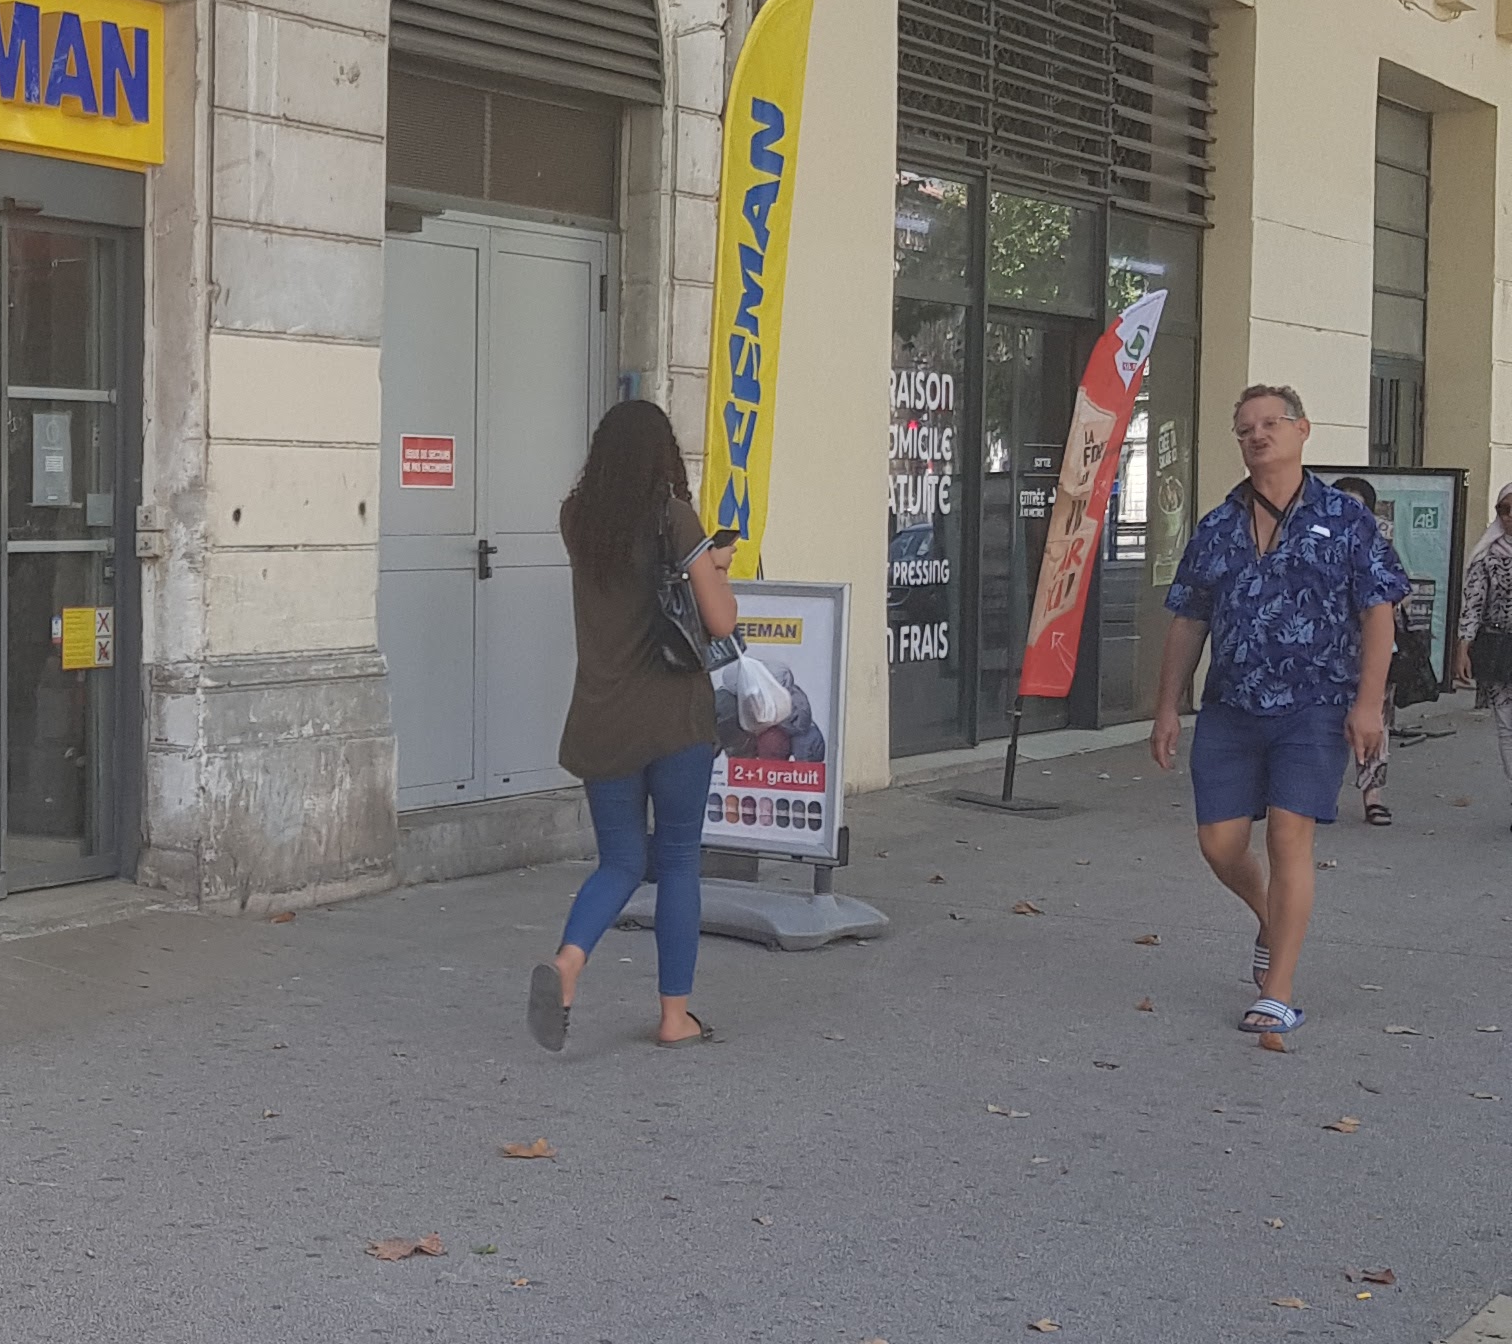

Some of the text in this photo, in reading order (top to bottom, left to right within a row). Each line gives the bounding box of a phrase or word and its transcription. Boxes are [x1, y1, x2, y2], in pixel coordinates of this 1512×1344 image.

[717, 96, 786, 541] ZEEMAN
[892, 558, 950, 586] PRESSING
[899, 621, 949, 663] FRAIS
[734, 765, 764, 781] 2+1
[767, 768, 819, 786] gratuit
